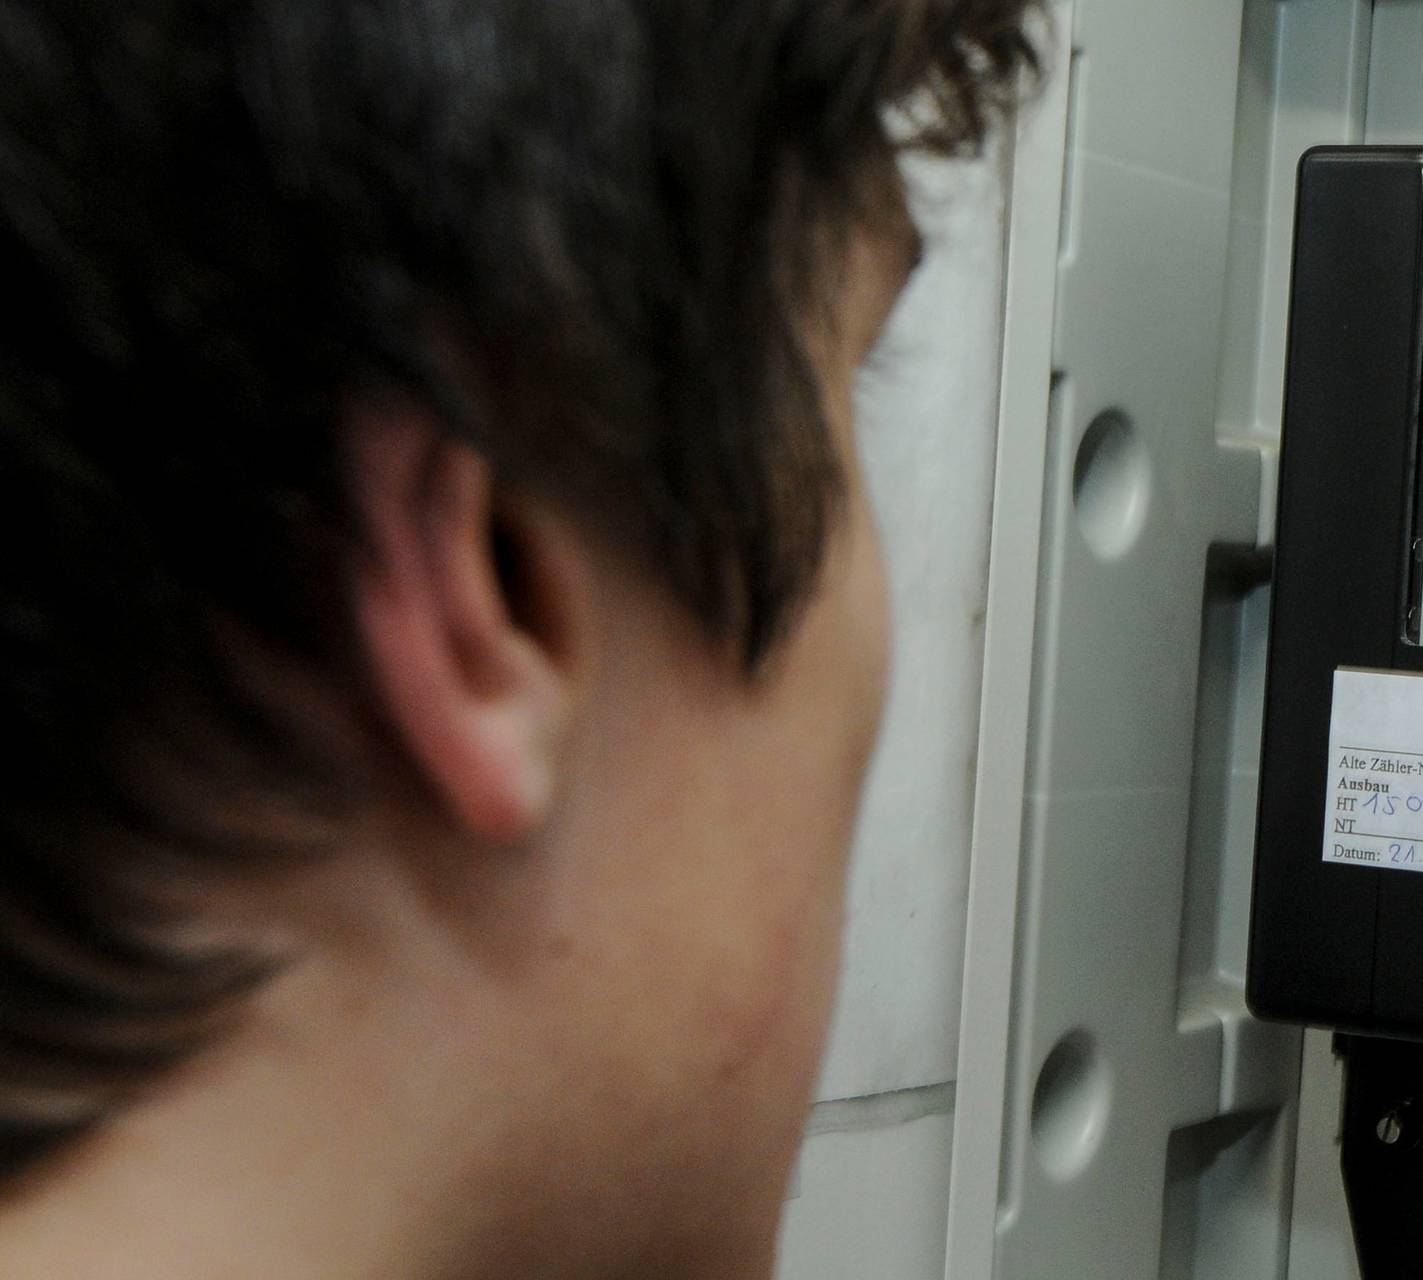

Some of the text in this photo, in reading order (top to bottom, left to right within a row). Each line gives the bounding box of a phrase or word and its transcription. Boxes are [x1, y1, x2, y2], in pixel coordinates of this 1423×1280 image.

[1338, 755, 1367, 771] Alte
[1337, 776, 1390, 794] Ausbau
[1336, 797, 1357, 812] HT
[1334, 818, 1357, 834] NT
[1333, 843, 1381, 862] Datum:
